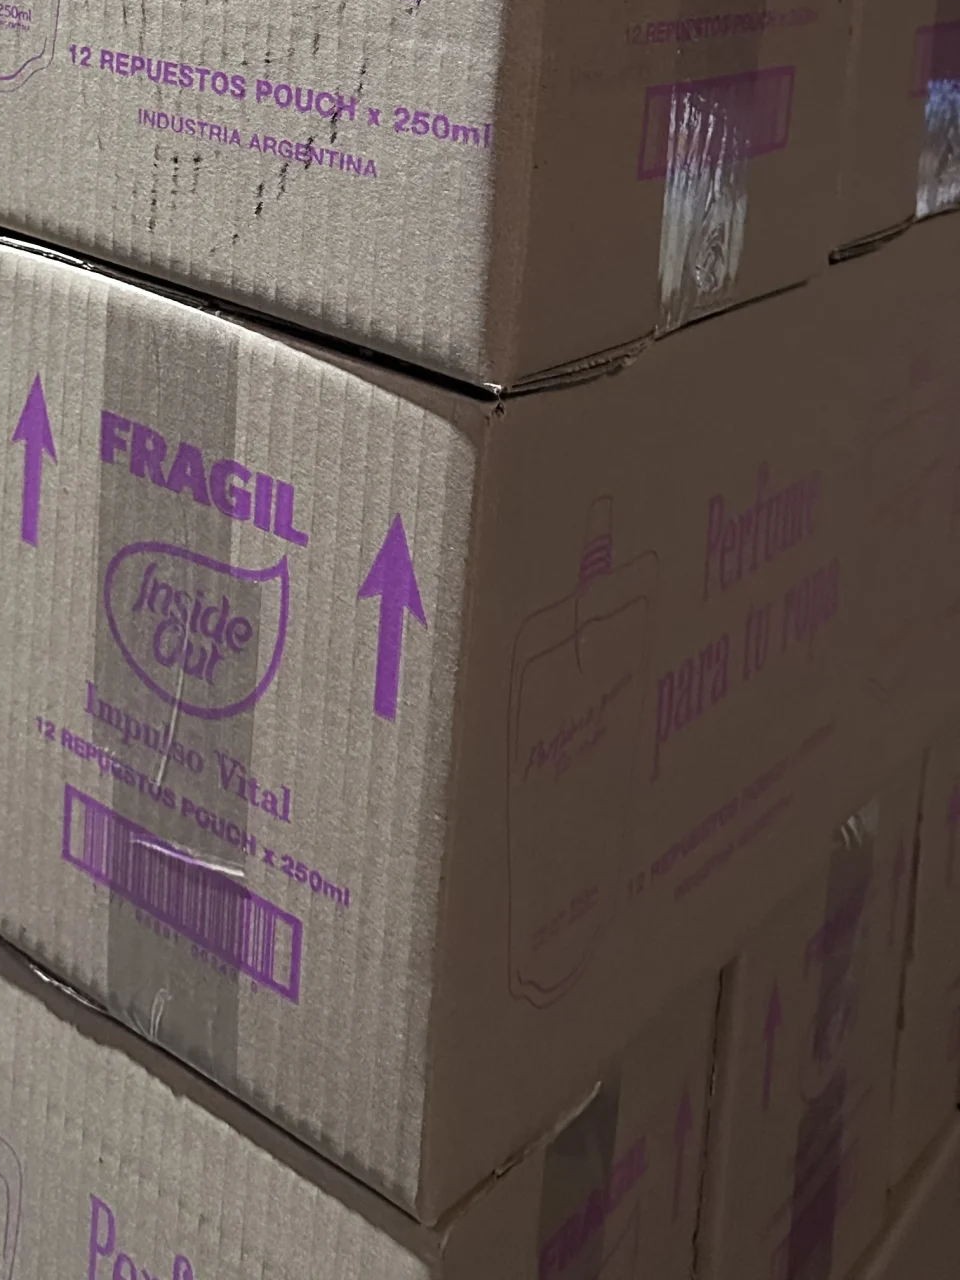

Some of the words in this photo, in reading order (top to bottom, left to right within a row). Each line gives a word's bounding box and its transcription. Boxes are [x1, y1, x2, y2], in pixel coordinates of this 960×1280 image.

[69, 44, 91, 67] 12
[100, 48, 246, 100] REPUESTOS
[255, 79, 358, 121] POUCH
[367, 107, 380, 126] x
[393, 106, 492, 149] 250ml
[138, 108, 241, 146] INDUSTRIA
[249, 133, 378, 178] ARGENTINA
[99, 410, 308, 548] FRAGIL
[702, 460, 821, 602] Perfume
[133, 562, 253, 652] Inside
[152, 618, 223, 686] Out
[84, 680, 204, 774] Impulso
[215, 748, 292, 824] Vital
[650, 631, 731, 783] para
[36, 715, 56, 742] 12
[60, 727, 177, 810] REPUESTOS
[180, 795, 257, 857] POUCH
[263, 846, 275, 867] x
[280, 854, 351, 909] 250ml
